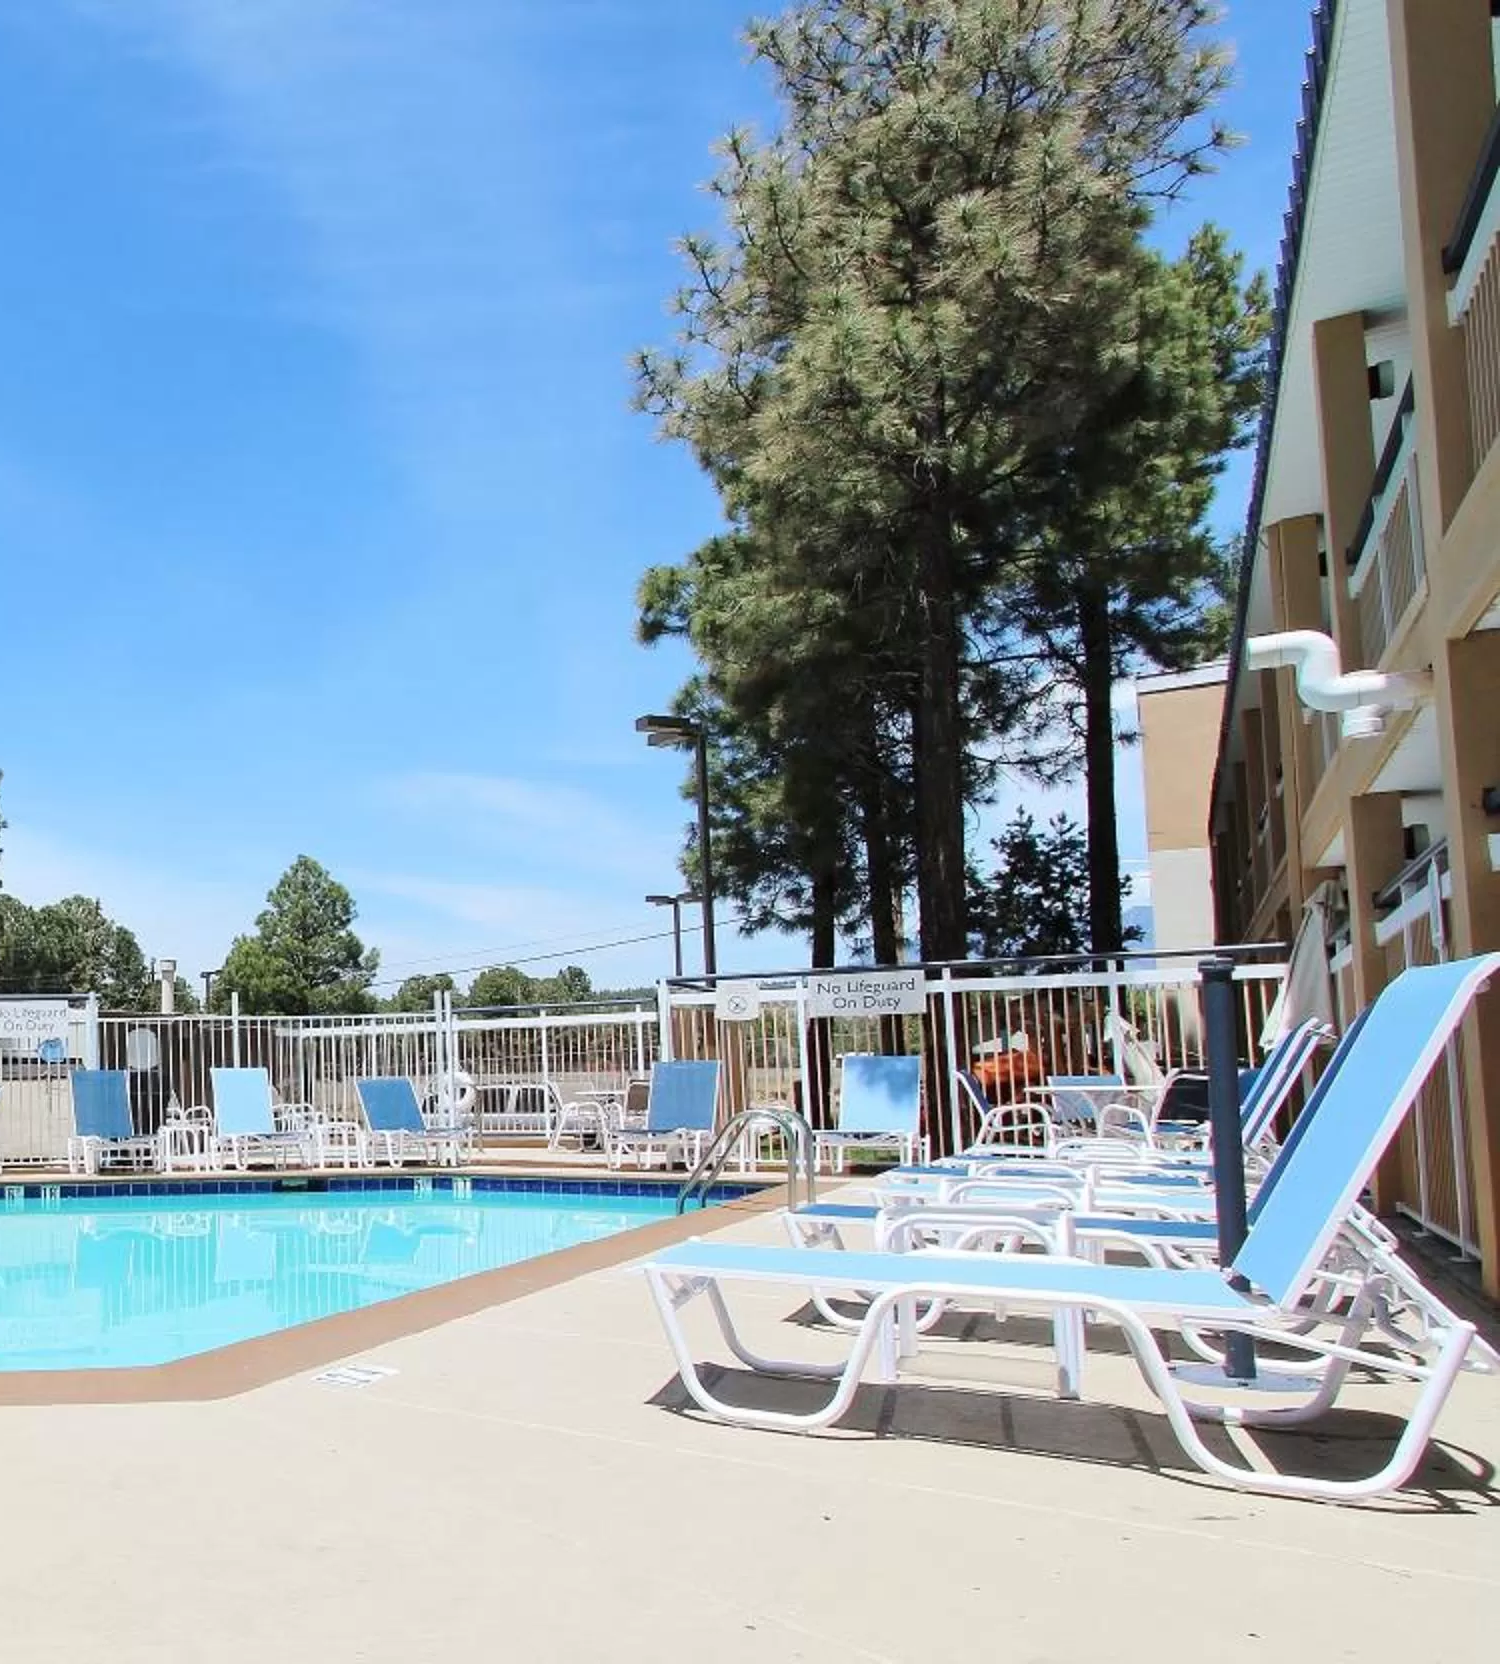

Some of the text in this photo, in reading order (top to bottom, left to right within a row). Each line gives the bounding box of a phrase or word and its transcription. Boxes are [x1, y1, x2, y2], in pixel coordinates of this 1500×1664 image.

[816, 977, 916, 997] No Lifeguard
[832, 995, 901, 1011] On Duty
[4, 1020, 23, 1032] On
